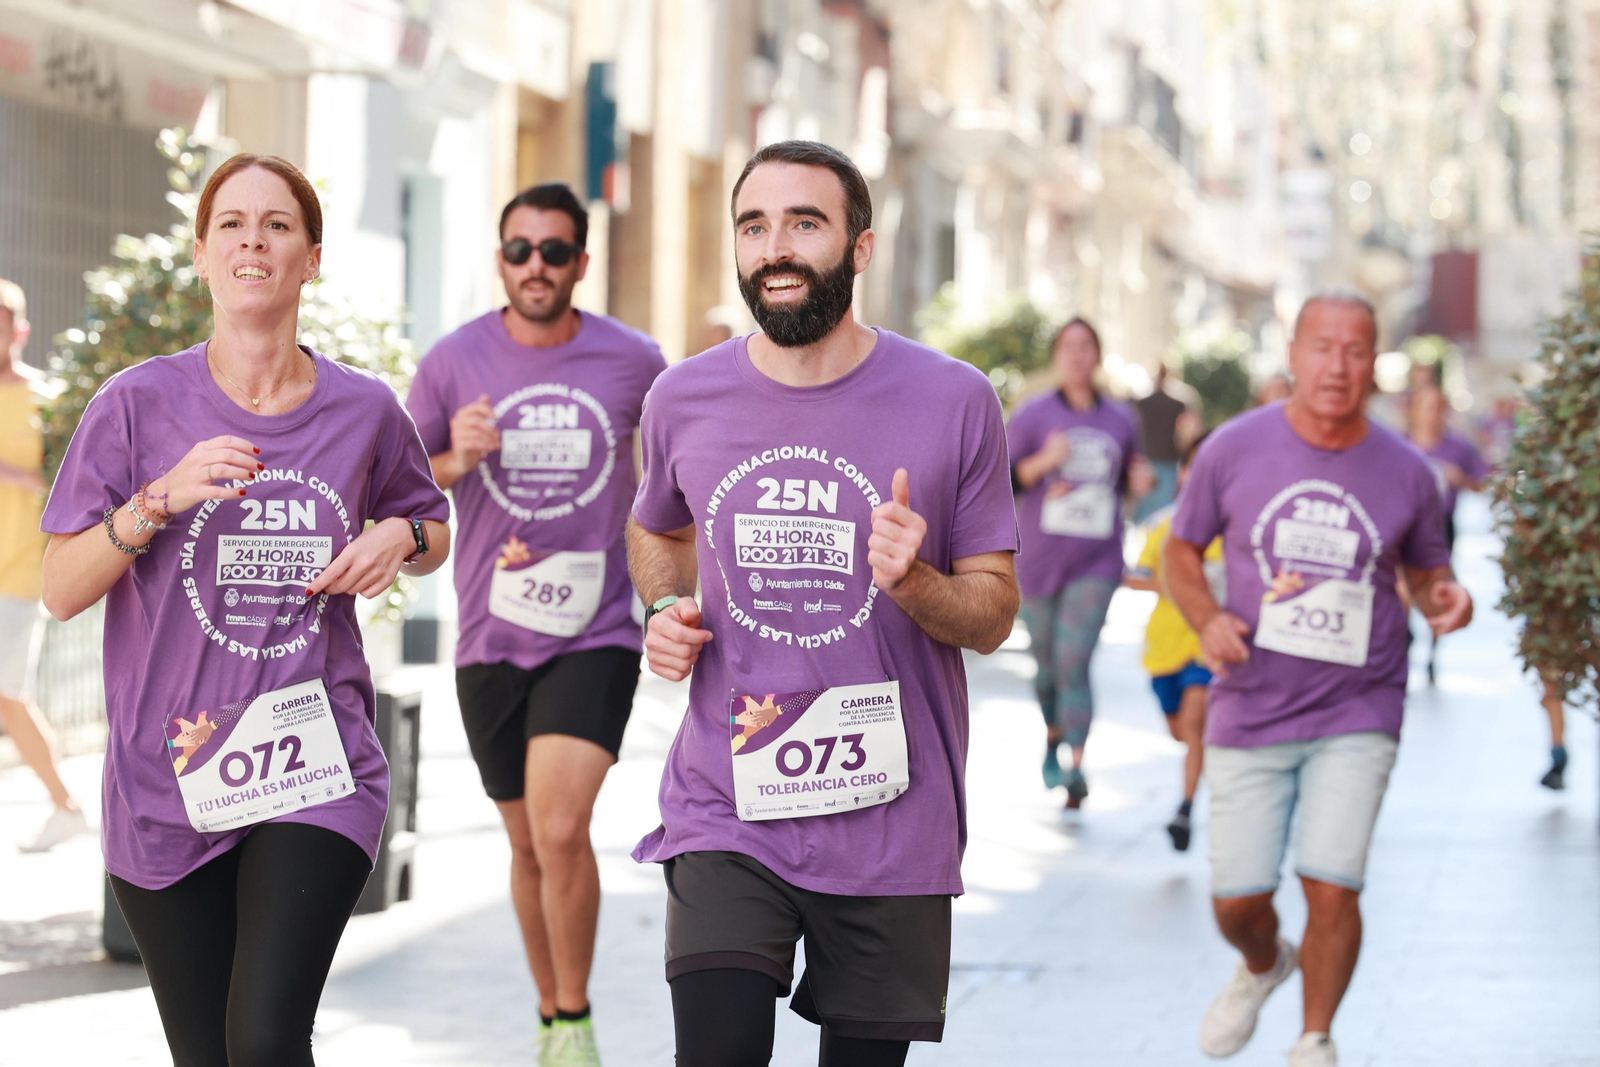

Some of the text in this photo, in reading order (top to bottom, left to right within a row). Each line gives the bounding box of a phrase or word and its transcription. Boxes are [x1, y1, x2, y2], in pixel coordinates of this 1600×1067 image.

[518, 404, 578, 429] 25N
[706, 446, 829, 516] INTERNACIONAL
[834, 457, 881, 510] CONTR
[308, 476, 350, 533] CONTRA
[756, 478, 838, 514] 25N
[239, 499, 316, 530] 25N
[739, 518, 778, 527] SERVICIO
[792, 520, 850, 534] EMERGENCIAS
[752, 530, 836, 546] 24 HORAS
[180, 541, 196, 570] DÍA
[235, 549, 315, 563] 24 HORAS
[741, 548, 846, 566] 900 21 21 30
[222, 566, 258, 580] 900
[262, 566, 278, 580] 21
[282, 566, 296, 580] 21
[523, 578, 572, 607] 289
[766, 578, 845, 590] Ayuntamiento de Cádiz
[286, 594, 296, 604] de
[804, 598, 822, 613] imd
[183, 577, 228, 646] MUJERES
[226, 614, 246, 622] fmm
[1290, 605, 1344, 634] 203
[758, 624, 792, 645] LAS
[796, 626, 846, 648] HACIA
[228, 640, 258, 661] LAS
[262, 634, 308, 660] HACIA
[272, 693, 321, 713] CARRERA
[841, 695, 893, 709] CARRERA
[860, 705, 894, 713] ELIMINACIÓN
[273, 722, 294, 731] CONTRA
[304, 712, 326, 722] MUJERES
[298, 708, 324, 719] VIOLENCIA
[219, 735, 306, 787] 072
[776, 733, 866, 777] 073
[196, 764, 343, 814] TU LUCHA ES MI LUCHA
[758, 772, 888, 796] TOLERANCIA CERO
